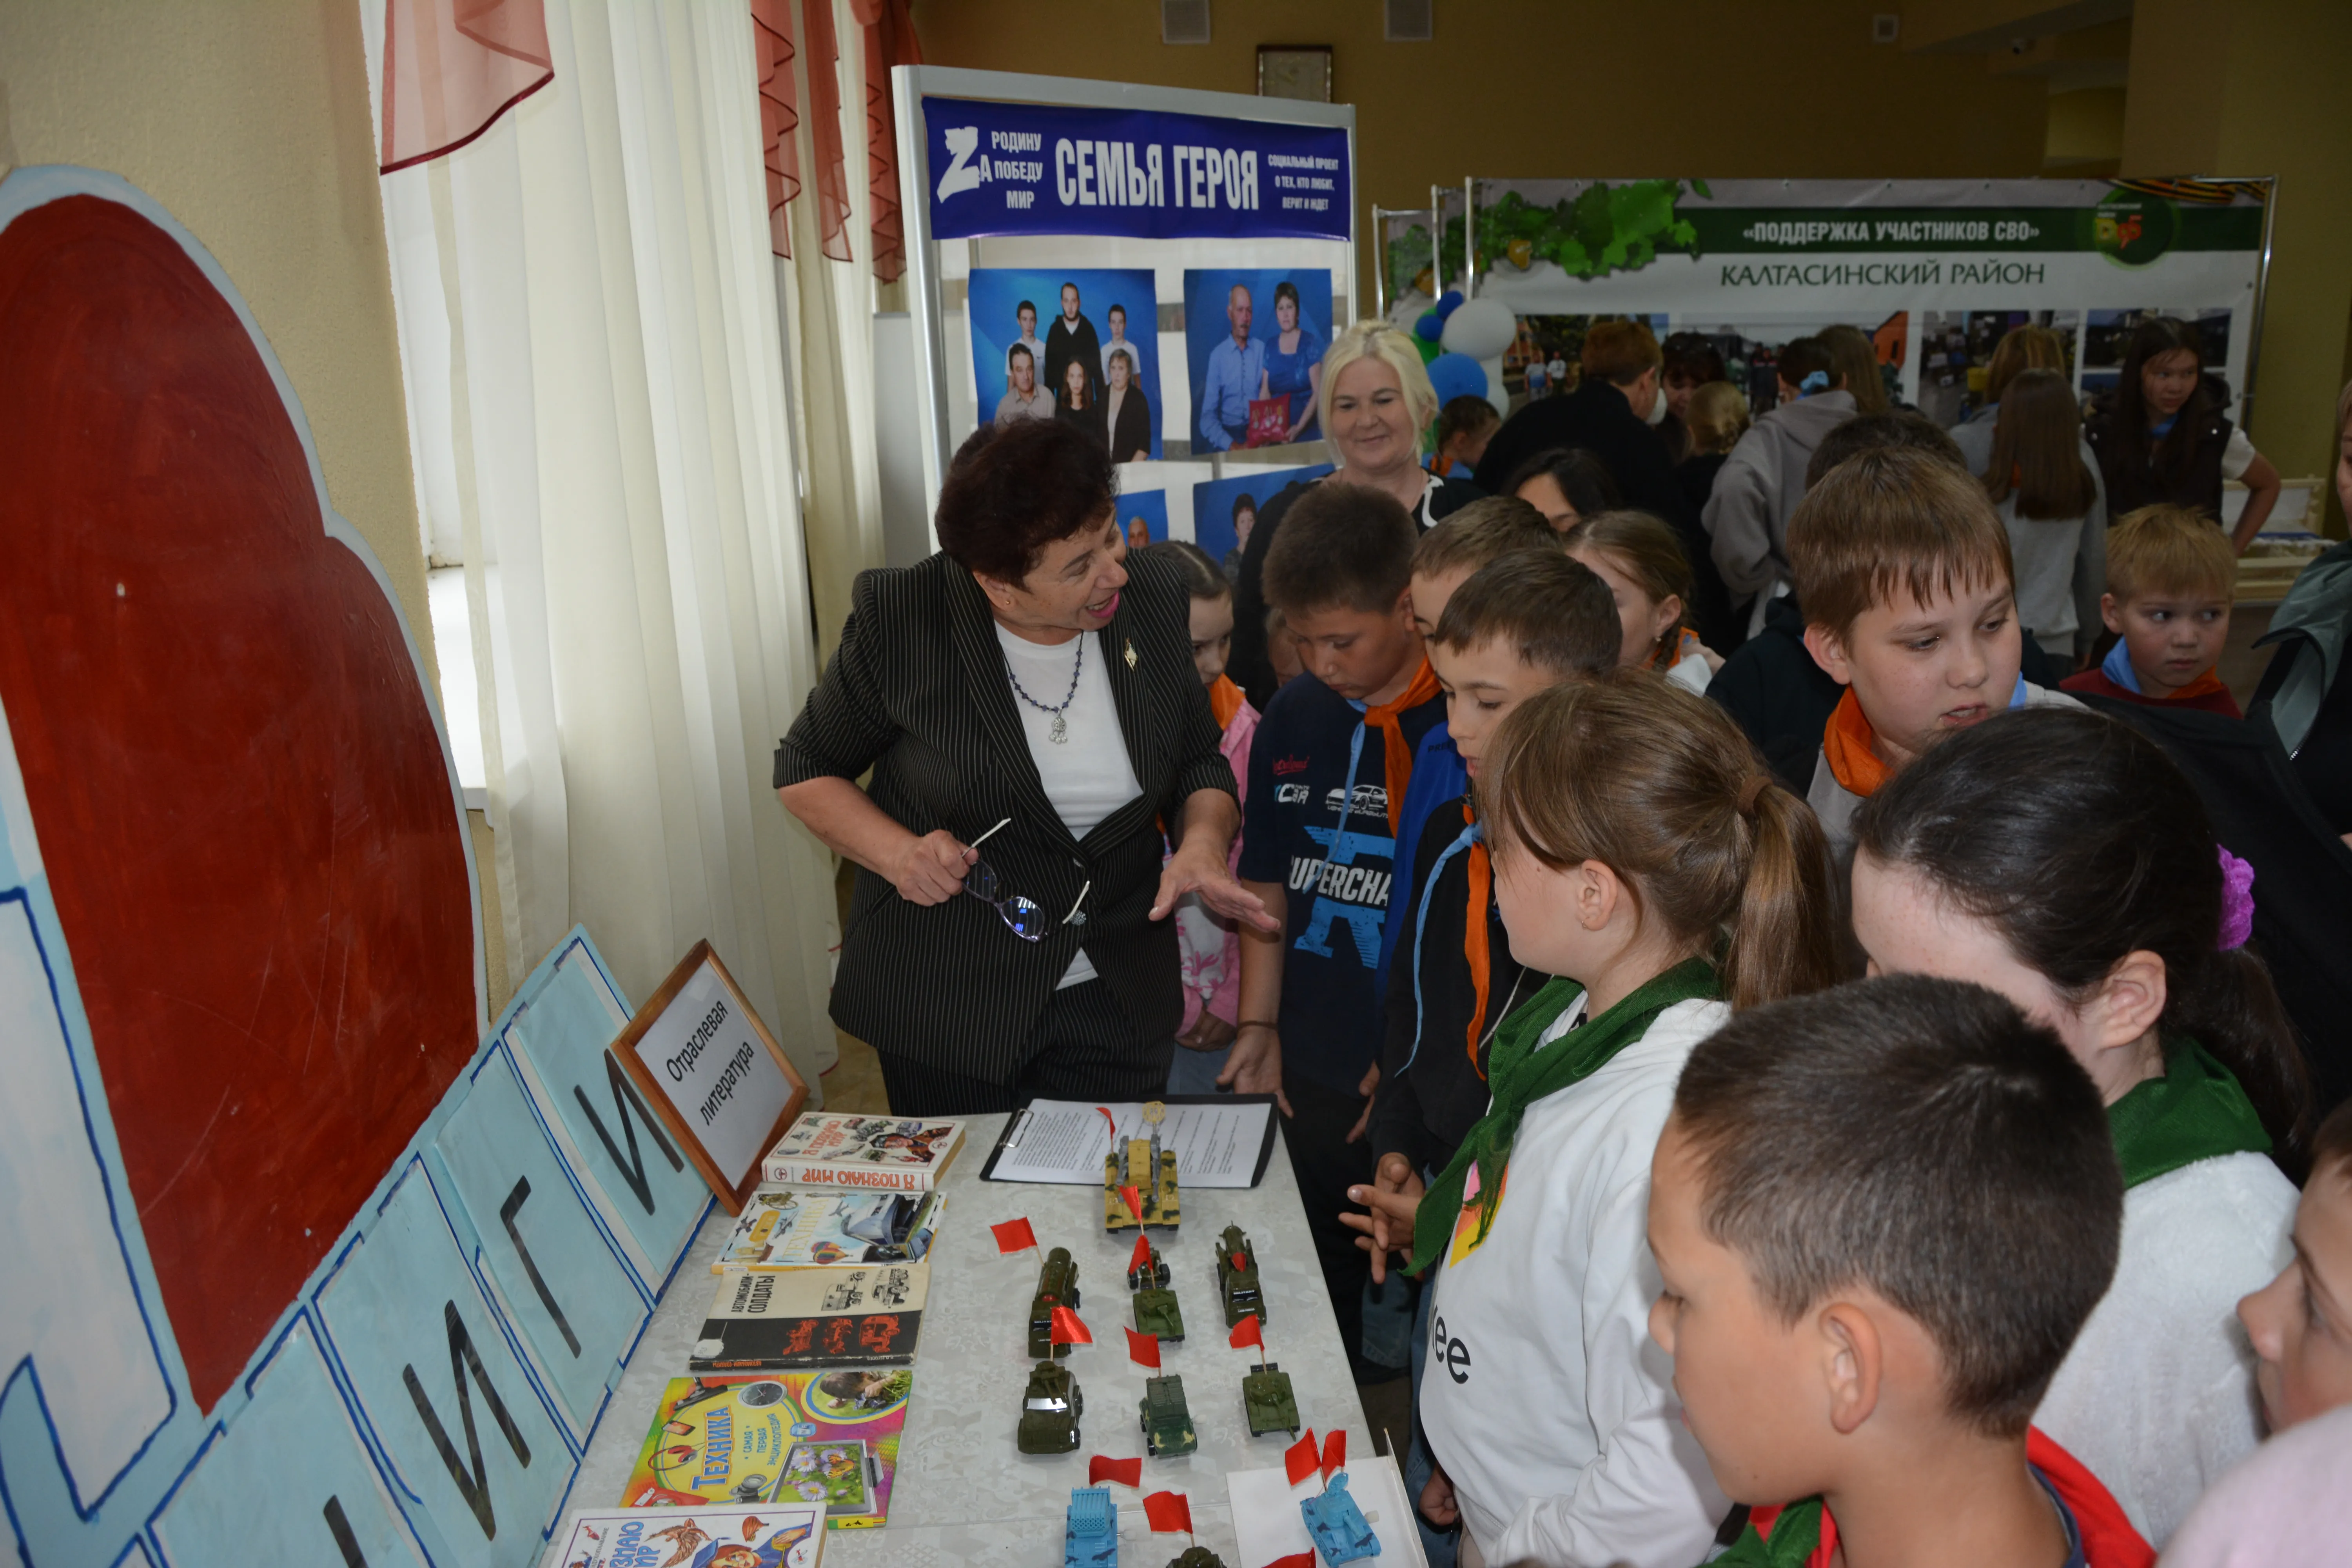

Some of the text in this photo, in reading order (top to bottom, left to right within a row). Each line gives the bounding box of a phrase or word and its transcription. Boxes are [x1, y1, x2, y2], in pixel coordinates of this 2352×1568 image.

[991, 131, 1041, 153] РОДИНУ
[994, 160, 1043, 183] ПОБЕДУ
[1055, 138, 1259, 210] СЕМЬЯ ГЕРОЯ
[1268, 154, 1338, 170] СОЦИАЛЬНЫЙ ПРОЕКТ
[1275, 175, 1280, 188] О
[1297, 177, 1309, 189] КТО
[1006, 190, 1034, 209] МИР
[1283, 197, 1303, 209] ВЕРИТ
[1304, 198, 1309, 209] И
[1742, 221, 2040, 246] «ПОДДЕРЖКА УЧАСТНИКОВ СВО»
[1721, 258, 2045, 286] КАЛТАСИНСКИЙ РАЙОН
[1289, 855, 1392, 907] UPERCHA
[666, 1000, 728, 1082] Отраслевая
[700, 1041, 754, 1126] литература
[802, 1168, 834, 1183] МИР
[837, 1170, 900, 1188] ПОЗНАЮ
[904, 1174, 915, 1190] Я
[747, 1275, 776, 1313] СОЛДАТЫ
[1431, 1304, 1471, 1385] ee
[690, 1406, 733, 1491] ТЕХНИКА
[743, 1430, 753, 1453] САМАЯ
[756, 1427, 767, 1453] ПЕРВАЯ
[766, 1413, 782, 1466] ЭНЦИКЛОПЕДИЯ
[610, 1521, 644, 1568] ЗНАЮ
[633, 1546, 661, 1568] ИР
